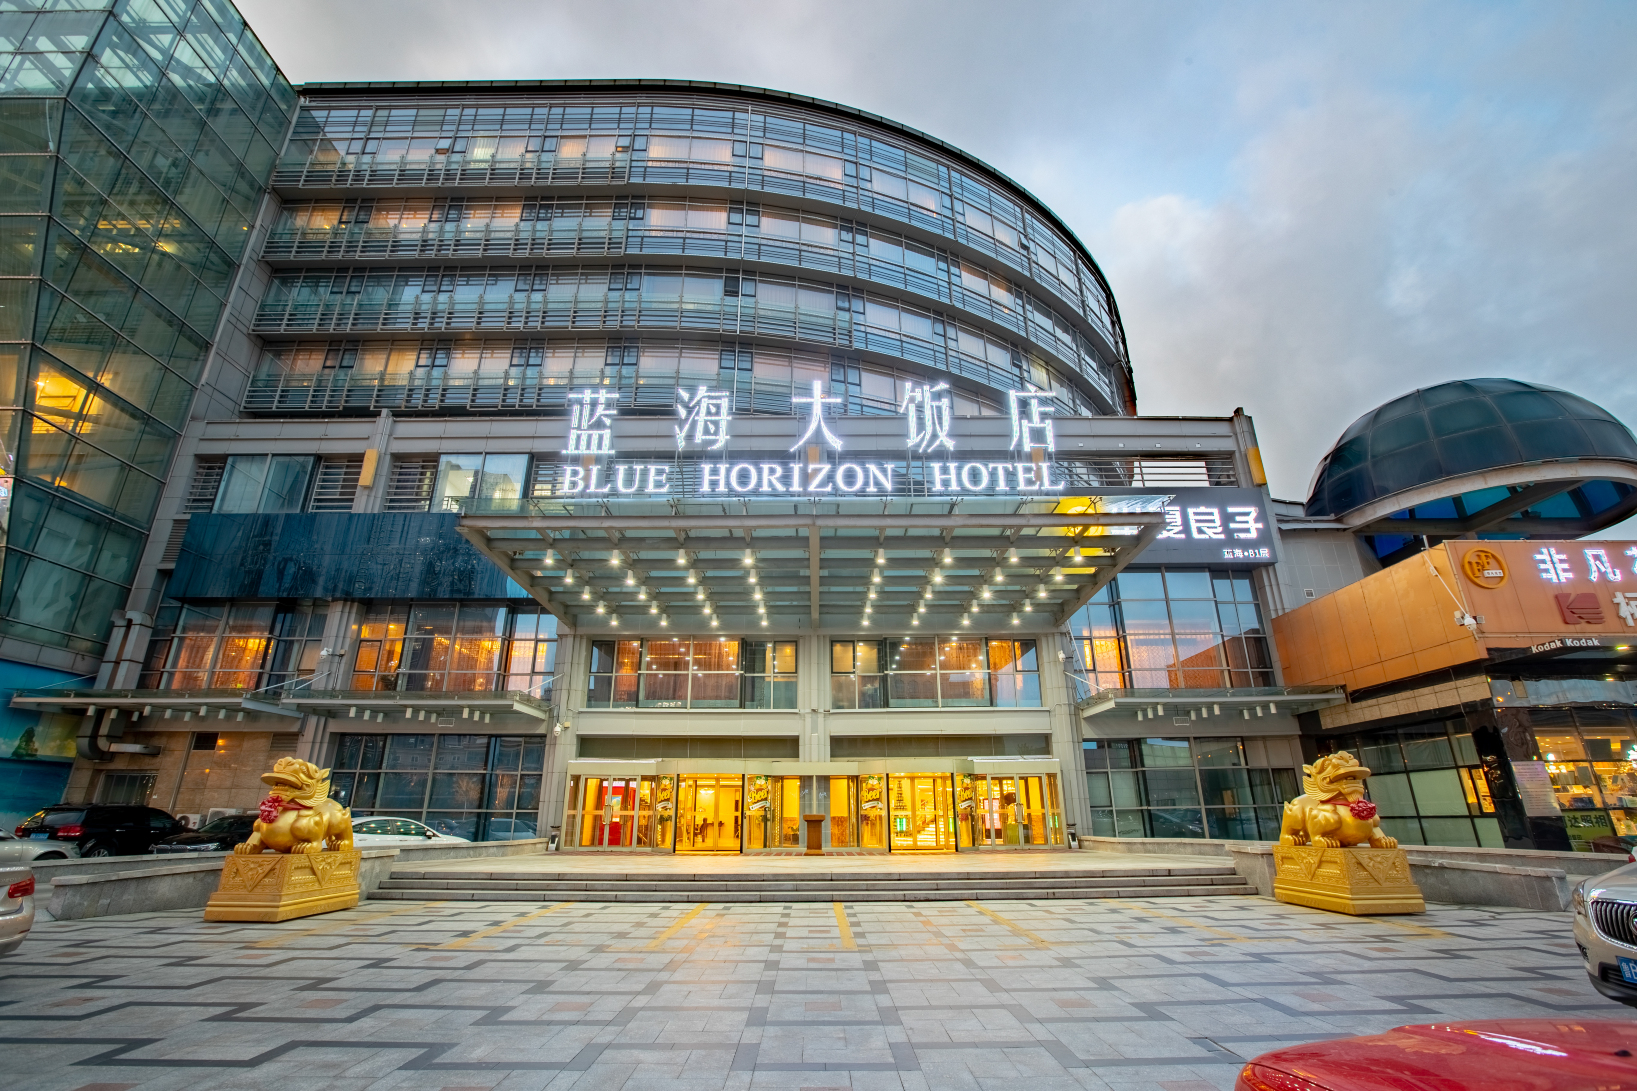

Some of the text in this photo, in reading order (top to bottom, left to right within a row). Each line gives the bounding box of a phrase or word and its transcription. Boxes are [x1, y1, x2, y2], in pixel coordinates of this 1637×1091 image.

[562, 380, 1056, 454] 蓝海大饭店
[560, 462, 1065, 493] BLUE HORIZON HOTEL
[1531, 638, 1600, 653] Kodak Kodak
